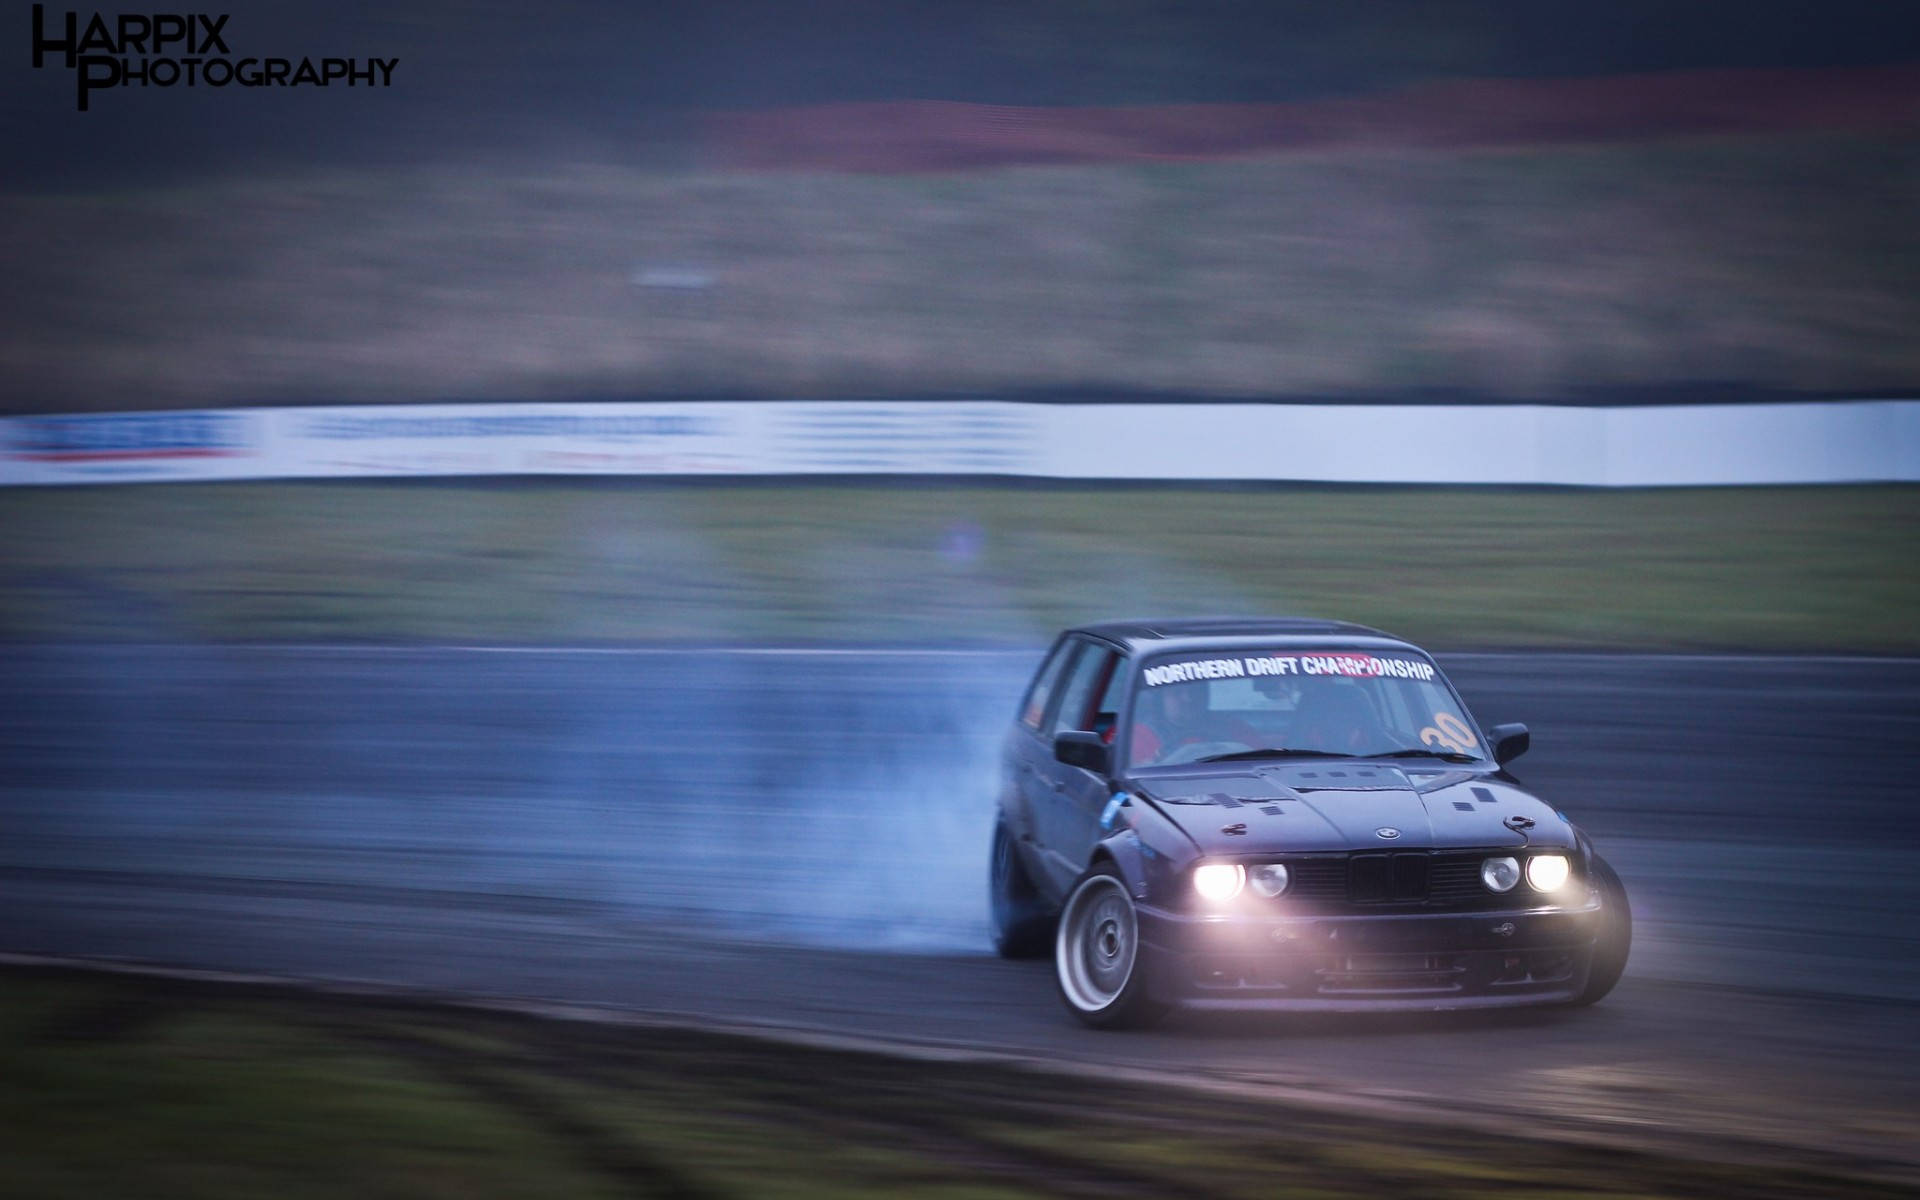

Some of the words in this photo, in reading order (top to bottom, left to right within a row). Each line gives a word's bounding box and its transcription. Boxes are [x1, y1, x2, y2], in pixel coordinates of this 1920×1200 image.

[1144, 658, 1243, 687] NORTHERN
[1247, 656, 1299, 677] DRIFT
[1303, 656, 1434, 681] CHAMPIONSHIP
[1420, 712, 1480, 755] 30
